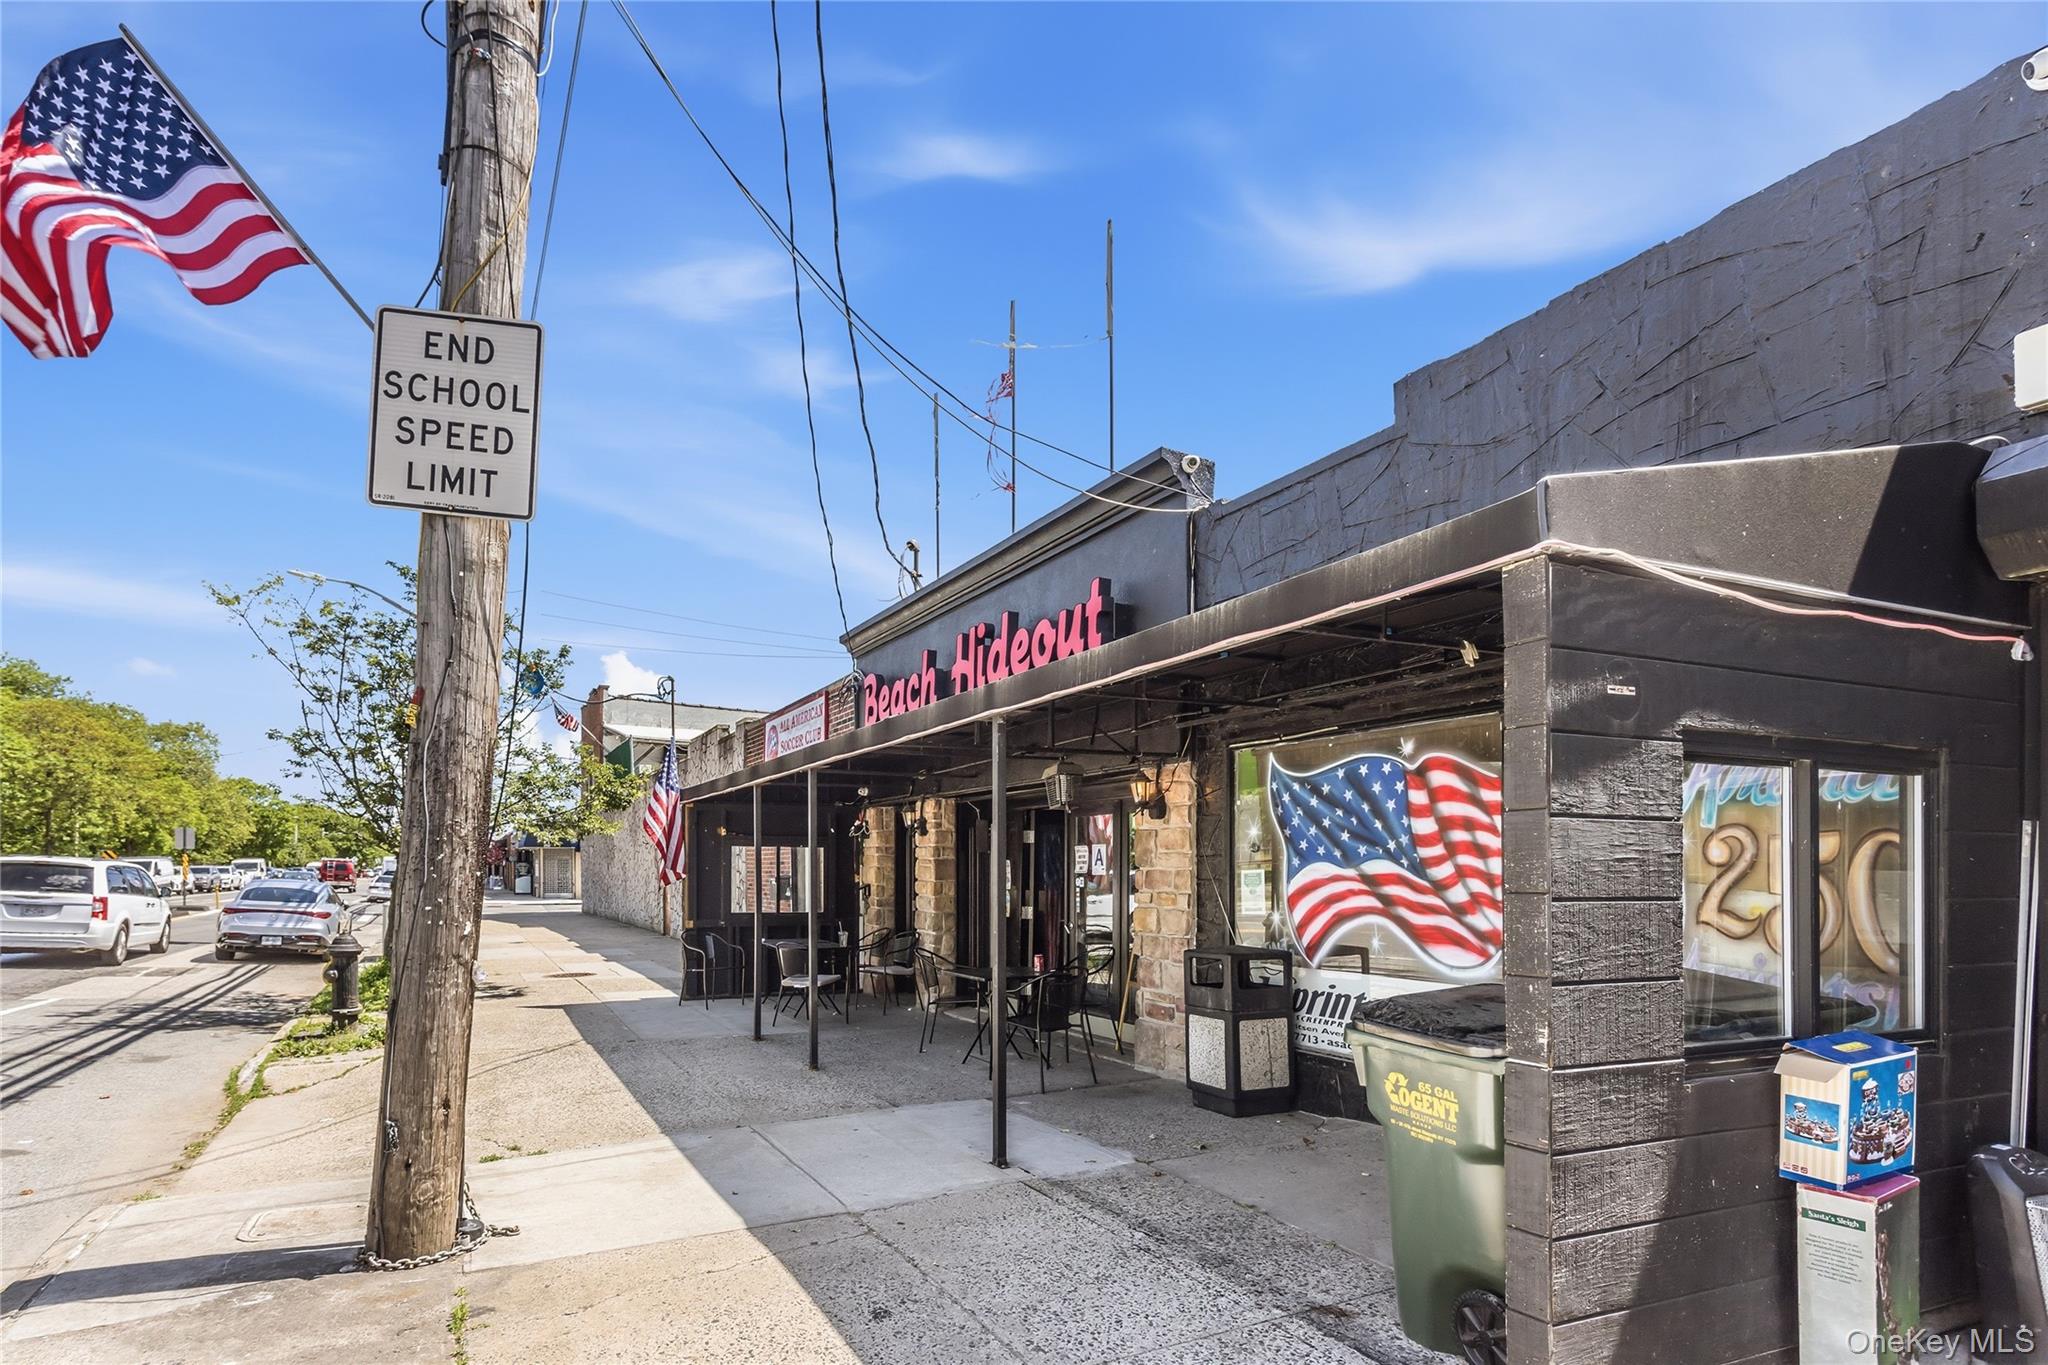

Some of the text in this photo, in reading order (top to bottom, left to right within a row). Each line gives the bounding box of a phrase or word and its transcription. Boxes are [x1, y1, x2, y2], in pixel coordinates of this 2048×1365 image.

[424, 330, 495, 365] END
[383, 370, 530, 414] SCHOOL
[395, 416, 514, 455] SPEED
[407, 461, 498, 498] LIMIT
[864, 577, 1104, 727] Beach Hideout
[780, 703, 824, 733] ALL AMERICAN
[780, 727, 821, 753] SOCCER CLUB
[1094, 848, 1104, 866] A
[1384, 1072, 1459, 1123] COGENT
[1418, 1081, 1458, 1103] 65 GAL
[1390, 1104, 1409, 1117] WASTE
[1410, 1110, 1444, 1129] SOLUTIONS
[1444, 1122, 1457, 1133] LLC
[1808, 1209, 1860, 1228] Santa's Sleigh
